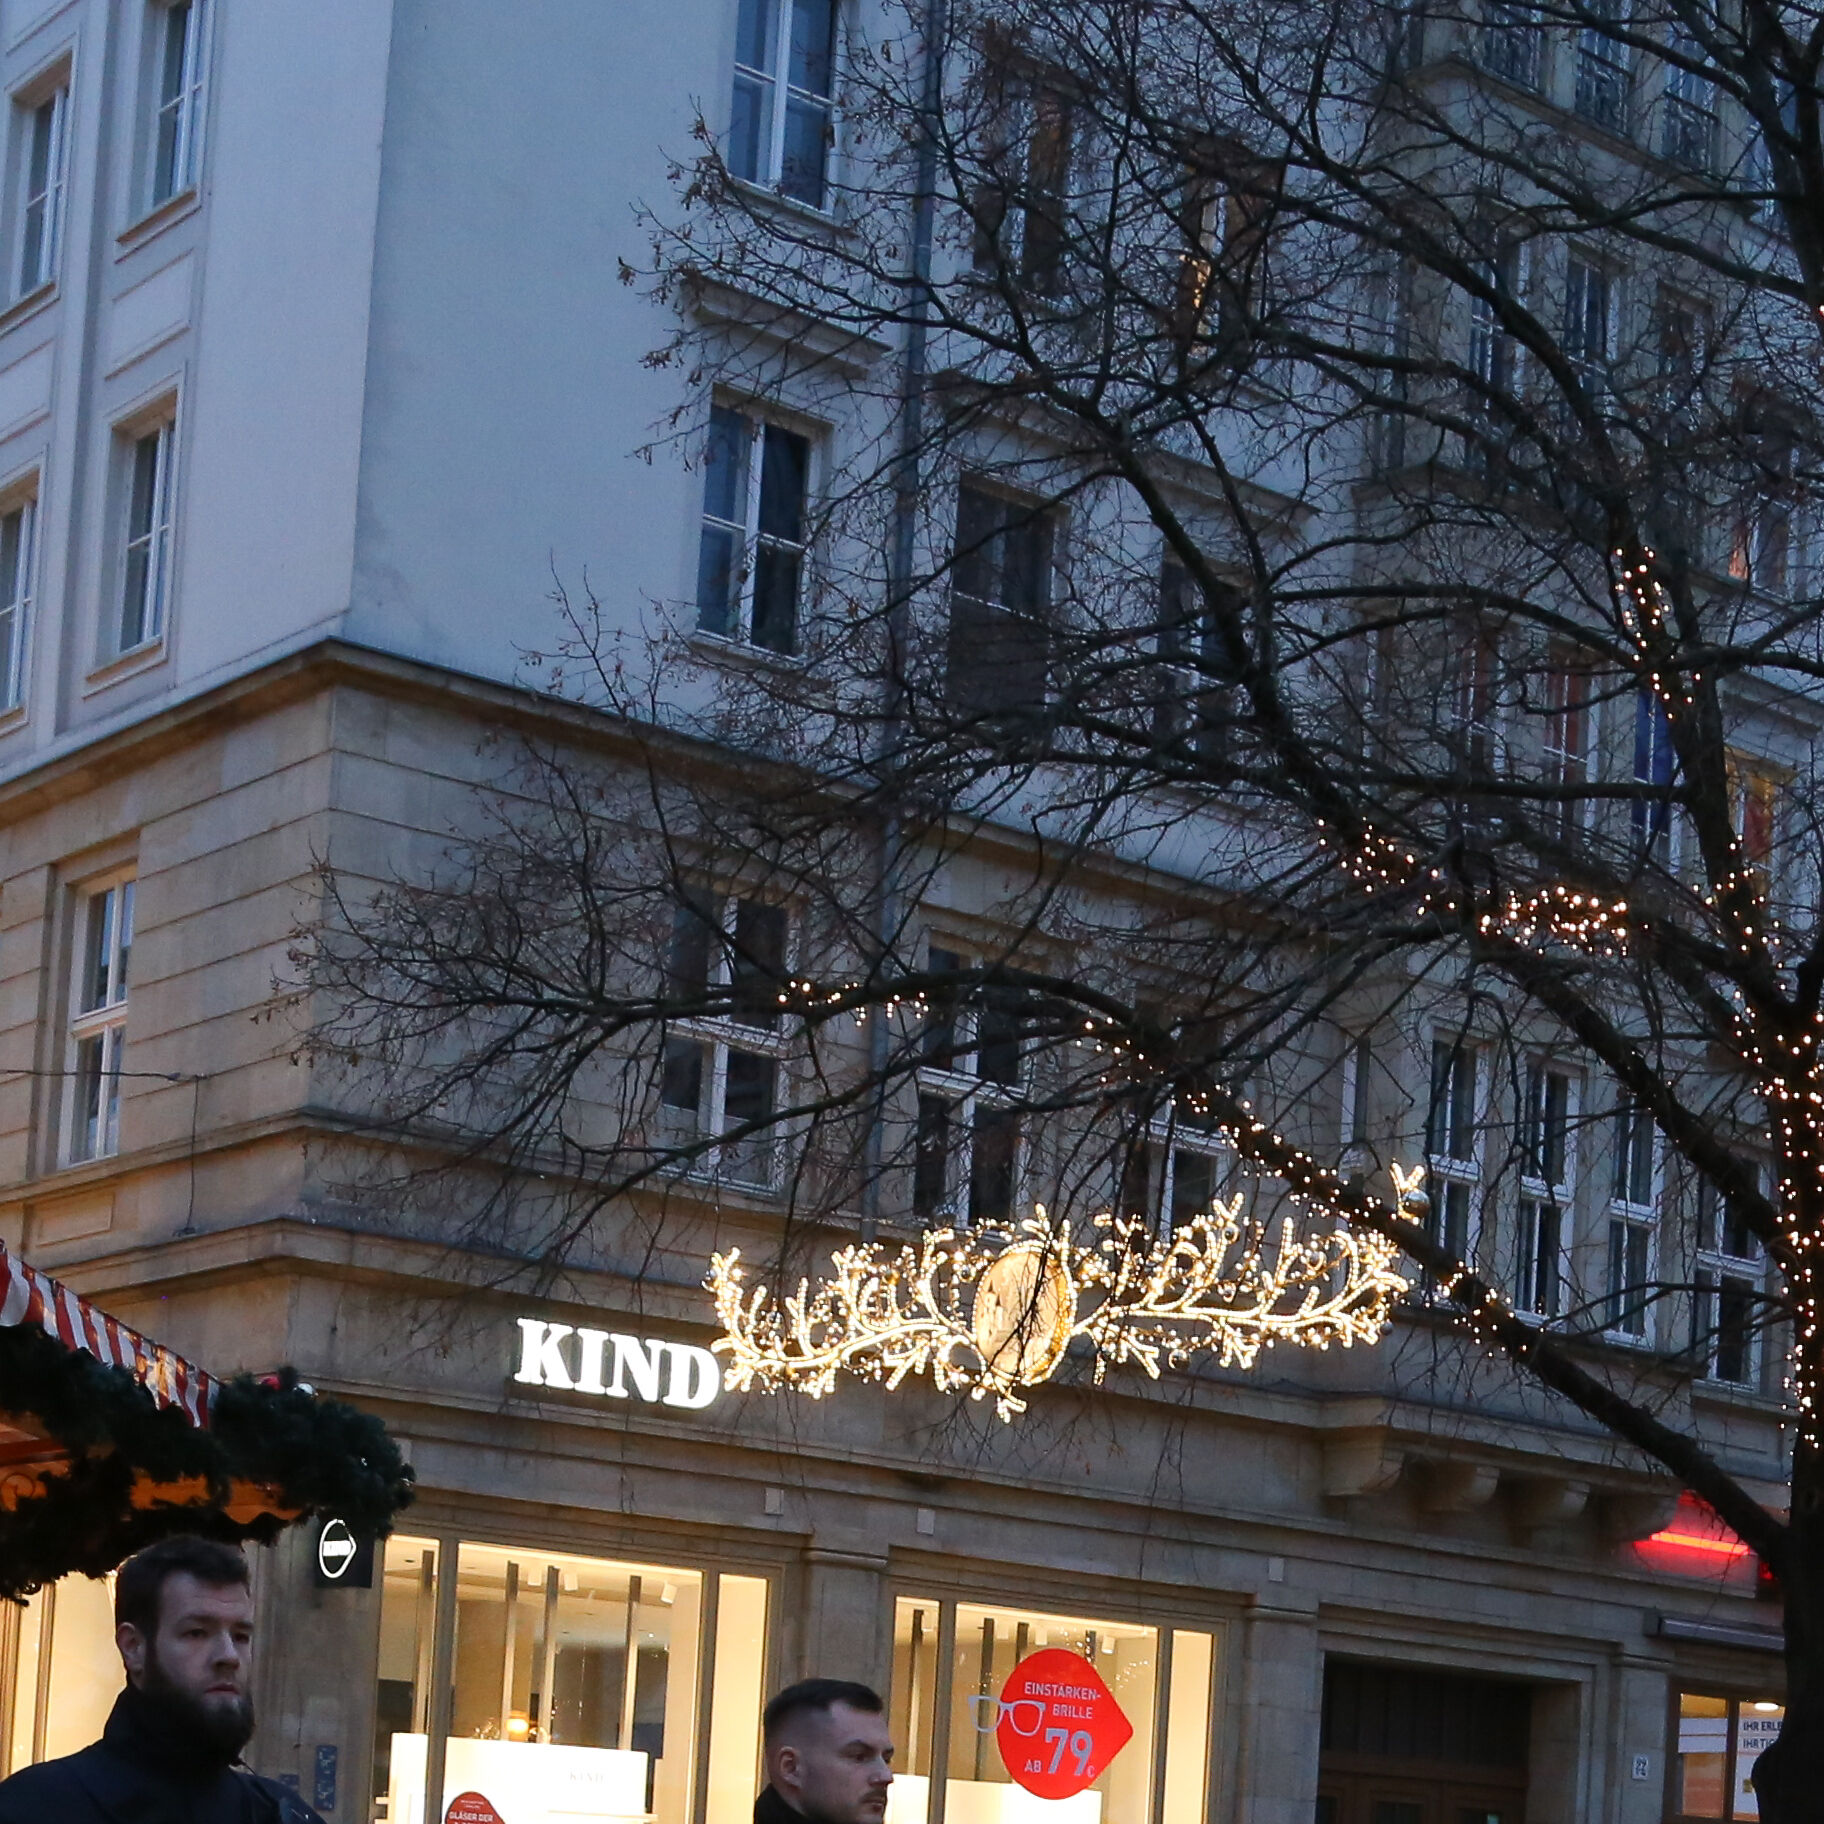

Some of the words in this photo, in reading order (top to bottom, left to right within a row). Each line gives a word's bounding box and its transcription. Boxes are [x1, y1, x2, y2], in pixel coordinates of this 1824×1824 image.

[513, 1318, 721, 1410] KIND
[1024, 1681, 1101, 1701] EINSTÄRKEN-
[1052, 1703, 1093, 1719] BRILLE
[1743, 1721, 1759, 1732] IHR
[1024, 1759, 1042, 1773] AB
[1044, 1727, 1093, 1777] 79
[1743, 1738, 1759, 1749] IHR
